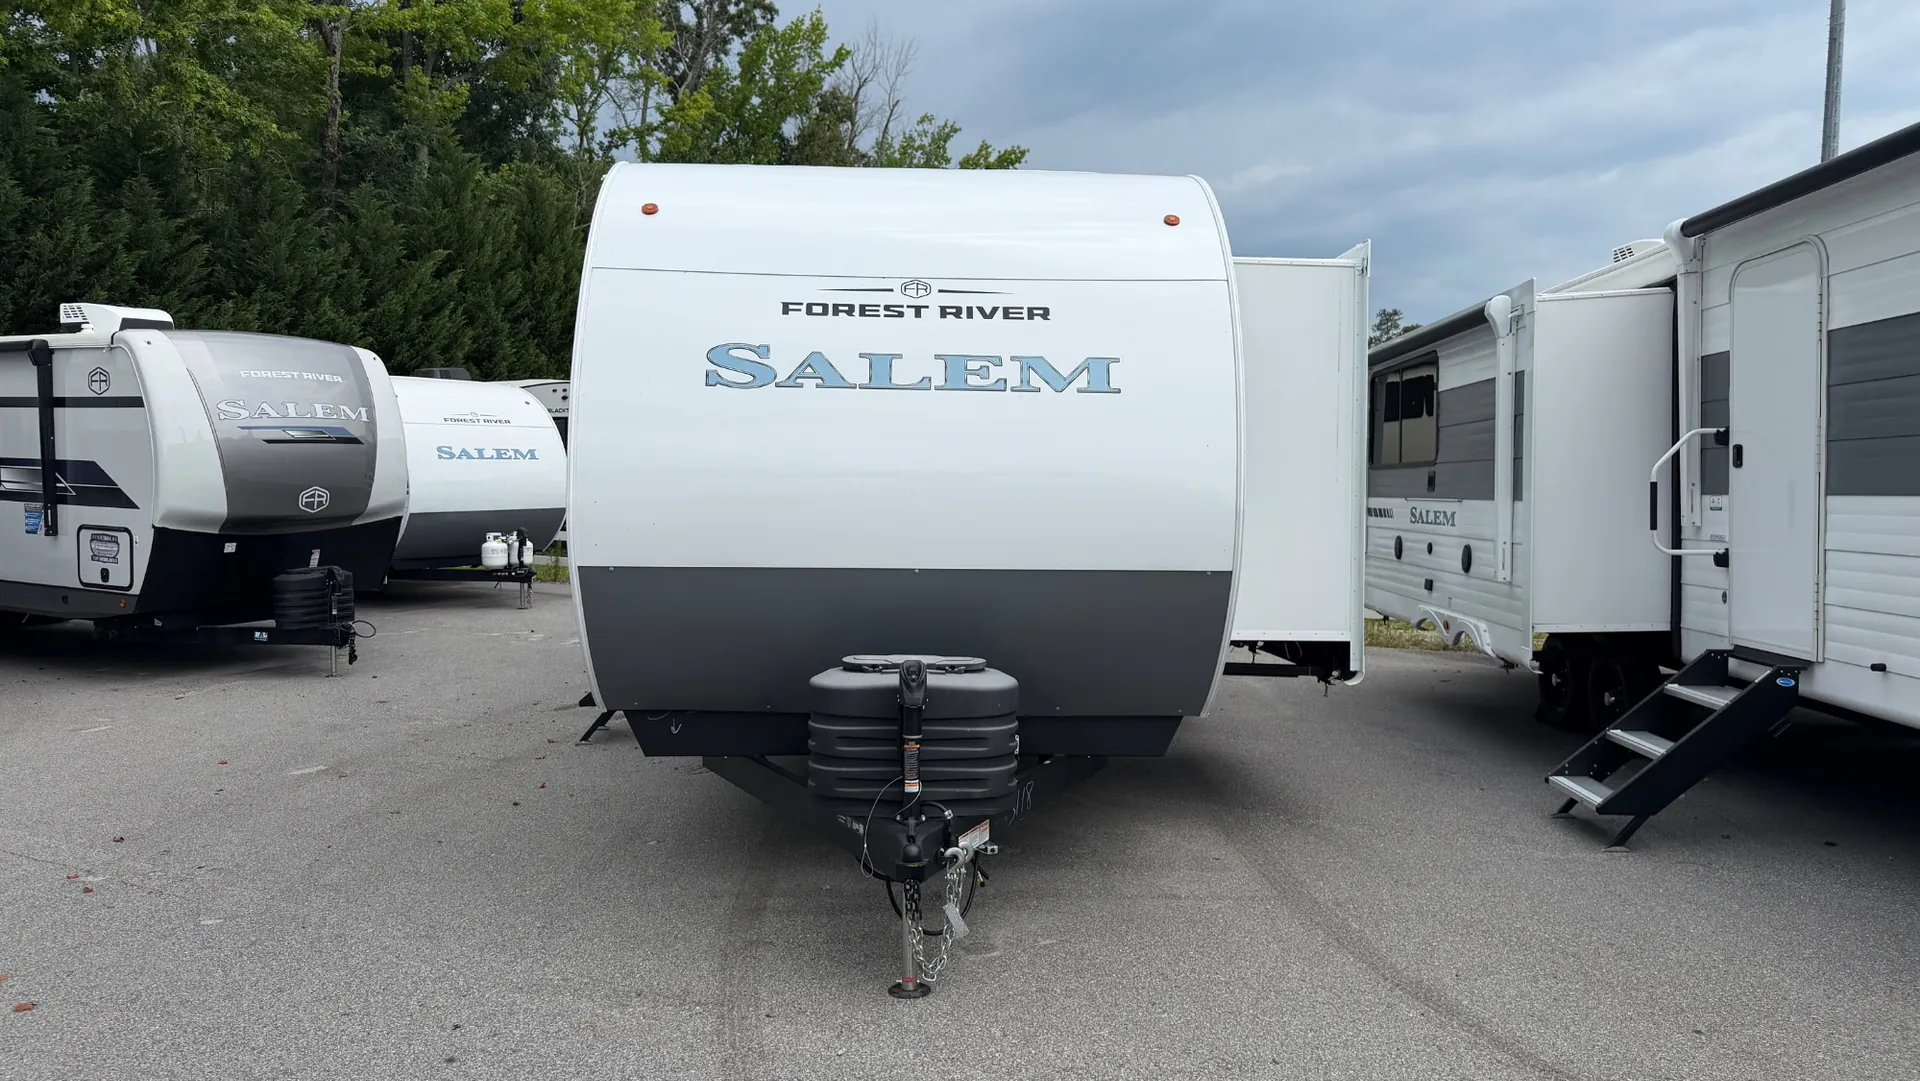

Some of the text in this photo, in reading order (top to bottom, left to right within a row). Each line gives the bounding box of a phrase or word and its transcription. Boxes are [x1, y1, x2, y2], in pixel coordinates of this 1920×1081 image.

[781, 302, 1051, 321] FOREST RIVER
[240, 370, 343, 383] FOREST RIVER
[705, 342, 1122, 395] SALEM
[216, 399, 370, 423] SALEM
[436, 445, 539, 460] SALEM
[1409, 506, 1457, 527] SALEM
